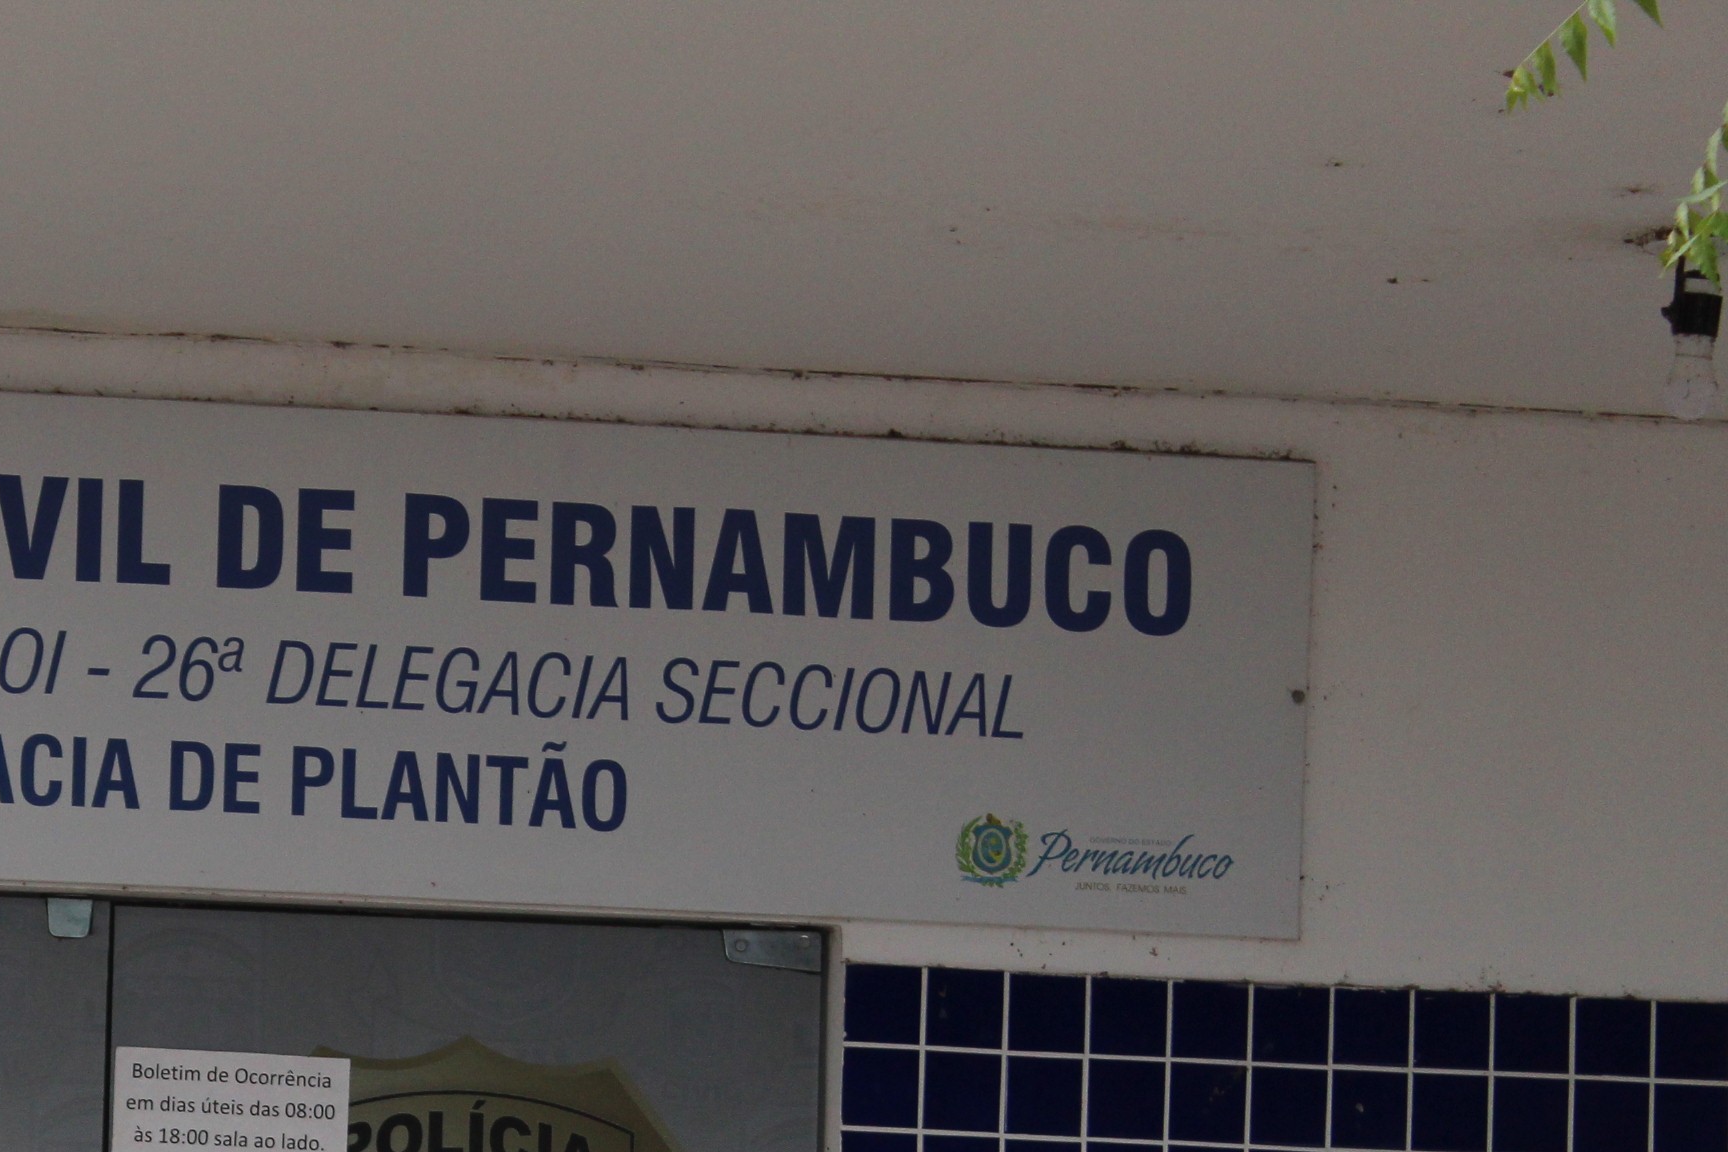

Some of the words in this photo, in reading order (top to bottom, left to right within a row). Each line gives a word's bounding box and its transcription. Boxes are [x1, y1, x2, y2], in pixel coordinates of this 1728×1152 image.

[217, 485, 355, 593] DE
[403, 493, 1191, 636] PERNAMBUCO
[133, 635, 244, 701] 26ª
[266, 640, 628, 720] DELEGACIA
[656, 658, 1023, 739] SECCIONAL
[170, 741, 260, 813] DE
[292, 741, 627, 832] PLANTÃO
[1026, 828, 1234, 880] Pernambuco
[133, 1063, 200, 1081] Boletim
[207, 1066, 228, 1082] de
[235, 1068, 331, 1088] Ocorrência
[127, 1098, 153, 1110] em
[160, 1096, 195, 1112] dias
[202, 1097, 243, 1115] úteis
[250, 1100, 279, 1117] das
[285, 1103, 335, 1119] 08:00
[134, 1126, 152, 1142] às
[160, 1128, 208, 1145] 18:00
[214, 1131, 247, 1147] sala
[254, 1137, 275, 1148] ao
[282, 1133, 324, 1151] lado.
